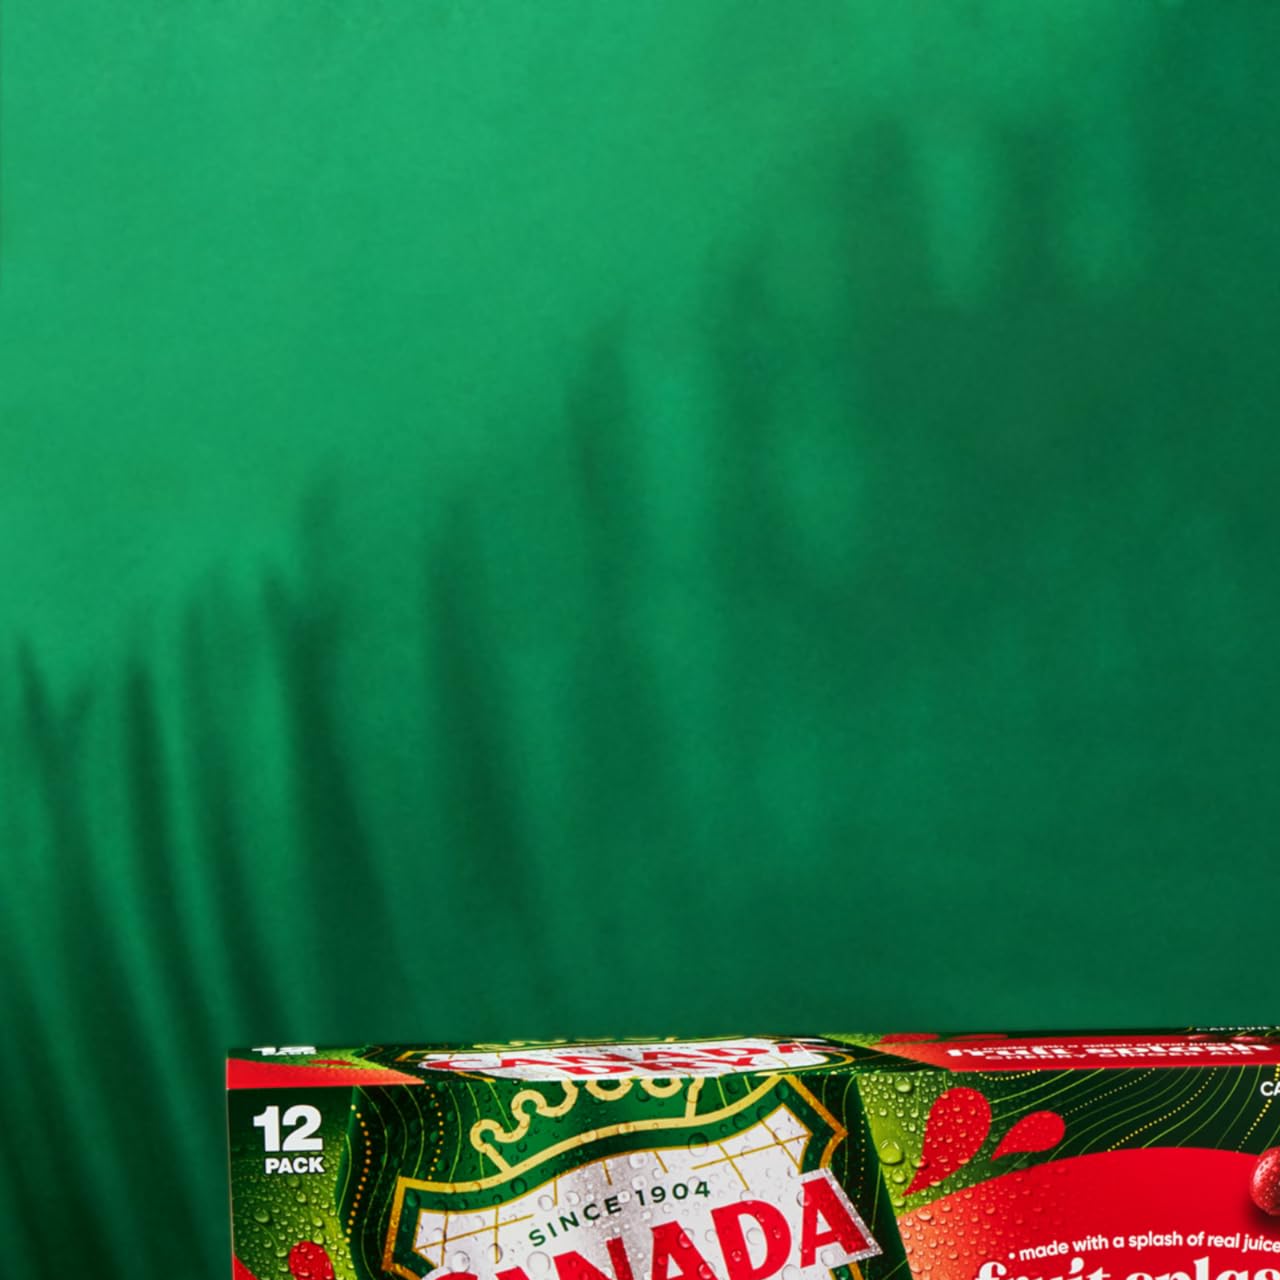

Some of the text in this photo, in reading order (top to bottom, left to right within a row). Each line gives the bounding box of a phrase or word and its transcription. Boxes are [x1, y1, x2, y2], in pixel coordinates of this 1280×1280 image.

[425, 1043, 840, 1071] CANADA
[253, 1104, 323, 1152] 12
[265, 1156, 325, 1174] PACK
[528, 1179, 711, 1247] SINCE 1904
[1019, 1240, 1069, 1261] made
[1072, 1234, 1109, 1252] with
[1112, 1236, 1125, 1248] a
[1128, 1231, 1181, 1250] splash
[1186, 1231, 1205, 1247] of
[1207, 1232, 1241, 1249] real
